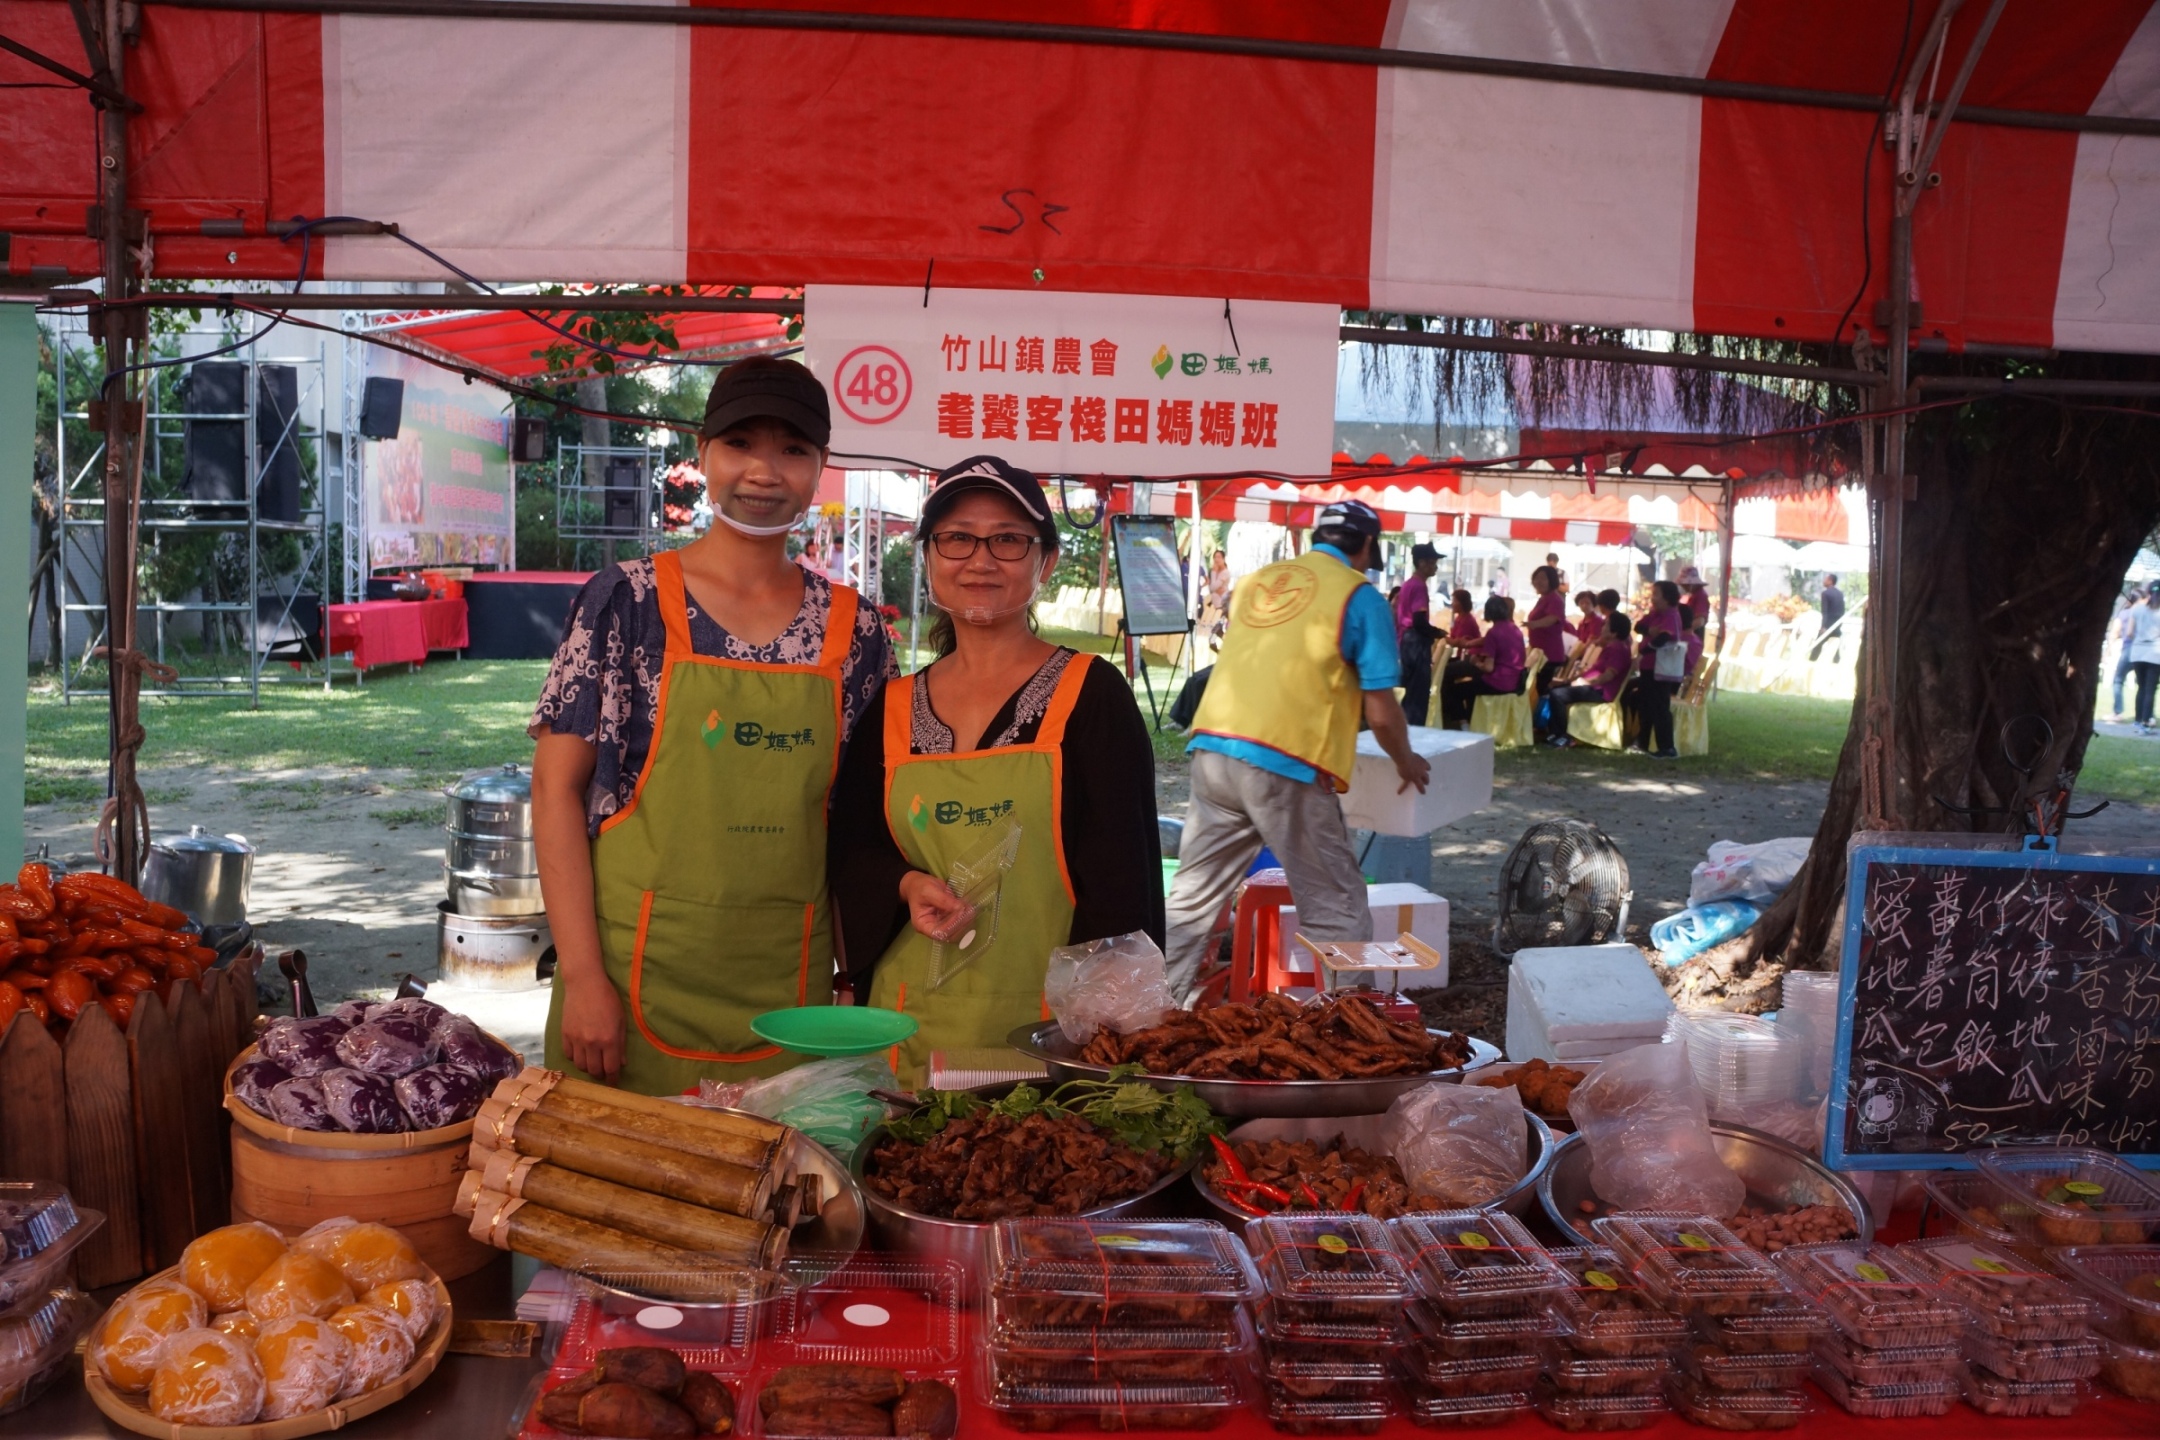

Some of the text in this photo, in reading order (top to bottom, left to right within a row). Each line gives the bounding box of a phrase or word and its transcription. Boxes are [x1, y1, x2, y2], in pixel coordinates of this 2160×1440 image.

[940, 333, 1119, 377] 竹山鎮農會
[1180, 353, 1272, 377] 田媽媽
[846, 363, 899, 406] 48
[937, 391, 1279, 449] 耄饕客棧田媽媽班
[733, 721, 815, 754] 田媽媽
